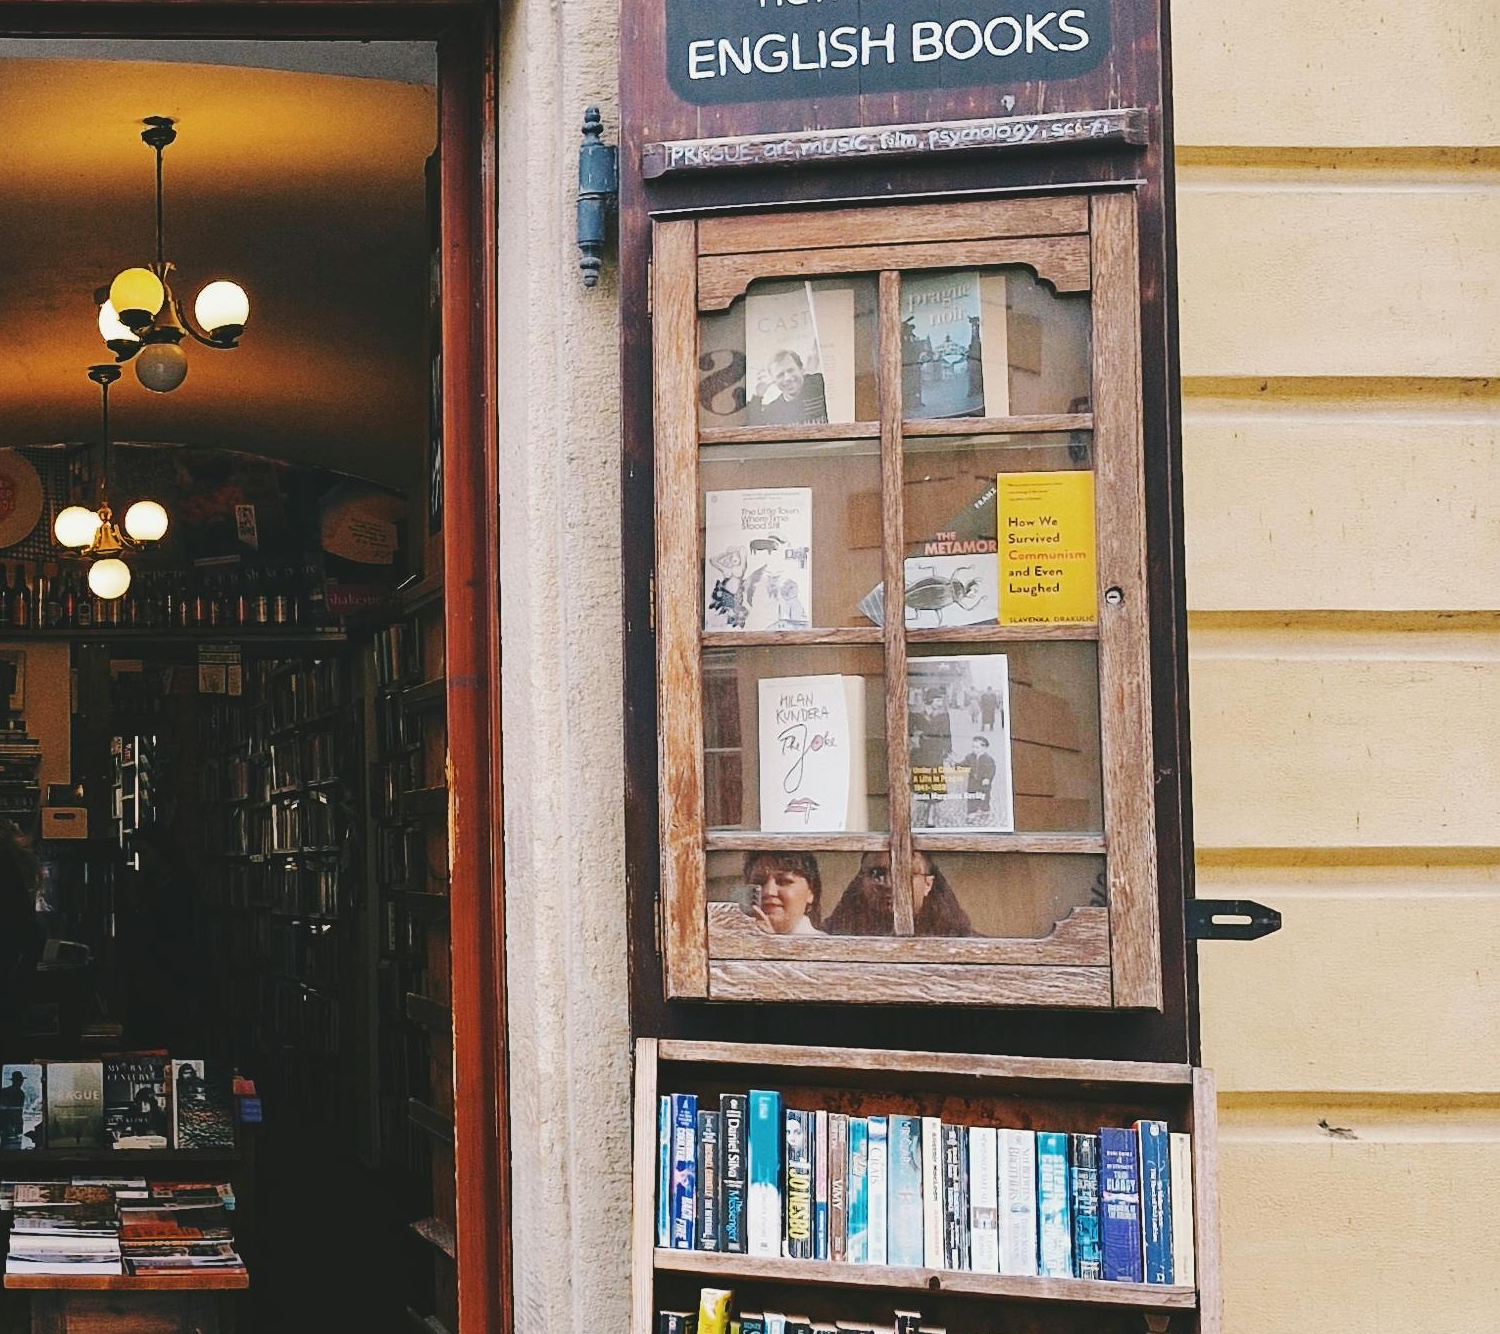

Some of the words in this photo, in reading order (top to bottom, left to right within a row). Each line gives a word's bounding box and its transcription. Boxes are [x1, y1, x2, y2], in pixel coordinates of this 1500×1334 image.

[687, 22, 895, 80] ENGLISH
[911, 8, 1089, 62] BOOKS
[909, 282, 971, 313] prague
[930, 306, 966, 326] noir
[973, 487, 997, 510] FRANZ
[1008, 517, 1036, 528] How
[1039, 516, 1058, 527] We
[936, 532, 957, 542] THE
[1008, 533, 1060, 544] Survived
[924, 540, 997, 556] METAMOR
[1008, 550, 1086, 561] Communism
[1008, 566, 1030, 577] and
[1035, 566, 1063, 576] Even
[1009, 583, 1060, 596] Laughed
[780, 692, 814, 708] MILAN
[776, 707, 829, 724] KUNDERA
[728, 1119, 739, 1152] Daniel
[728, 1154, 740, 1177] Silva
[726, 1190, 738, 1241] Messenger
